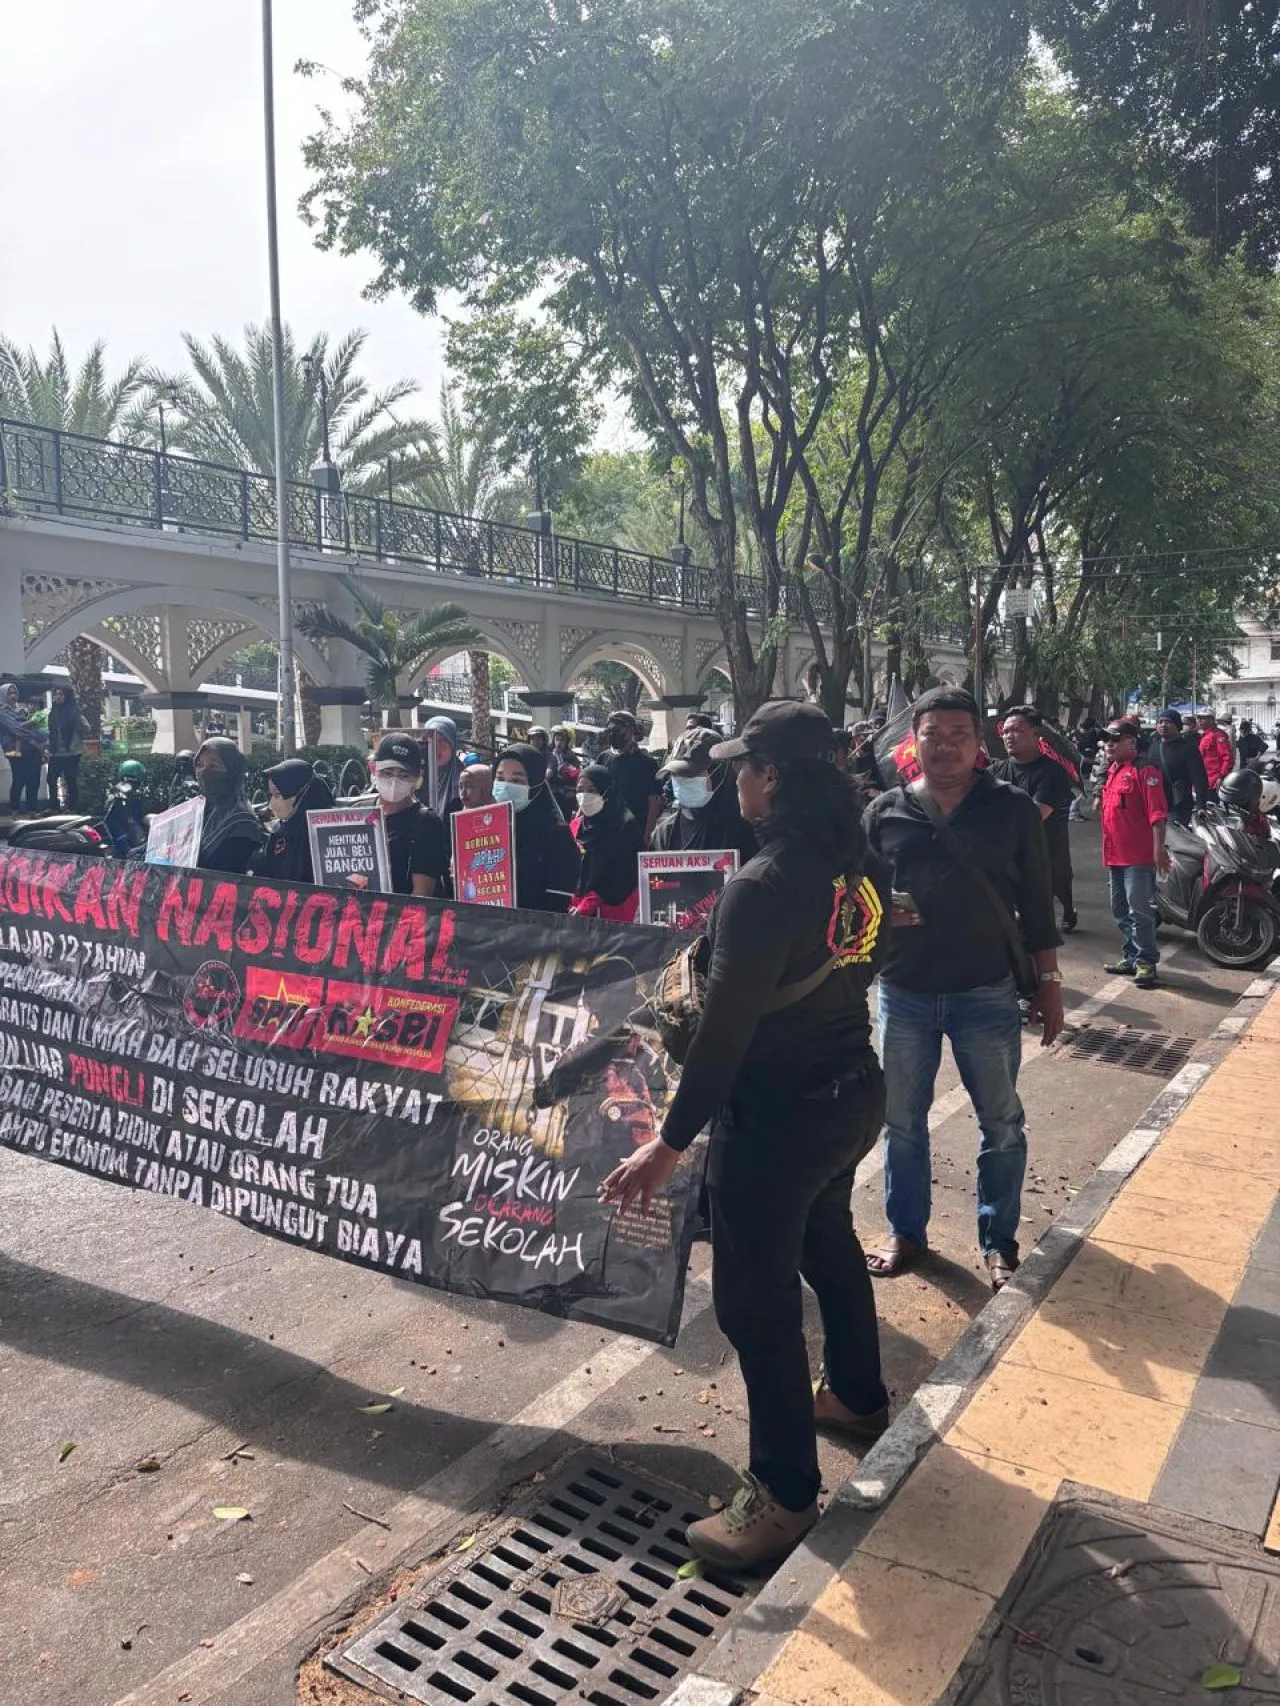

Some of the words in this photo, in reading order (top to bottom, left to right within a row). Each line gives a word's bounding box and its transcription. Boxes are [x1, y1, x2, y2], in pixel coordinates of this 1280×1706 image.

[324, 846, 351, 858] JUAL
[324, 857, 374, 873] BANGKU
[643, 856, 684, 868] SERUAN
[687, 856, 710, 867] AKSI
[157, 874, 469, 985] NASIONAL
[59, 934, 79, 962] 12
[82, 941, 146, 979] TAHUN
[387, 995, 448, 1014] KONFEDERASI
[42, 1007, 75, 1042] DAN
[148, 1034, 200, 1072] BAGI
[202, 1047, 314, 1099] SELURUH
[319, 1072, 443, 1125] RAKYAT
[69, 1053, 145, 1107] PUNGLI
[152, 1076, 174, 1117] DI
[182, 1086, 328, 1159] SEKOLAH
[0, 1075, 41, 1110] BAGI
[39, 1088, 112, 1137] PESERTA
[115, 1110, 161, 1154] DIDIK
[165, 1130, 226, 1174] ATAU
[228, 1149, 316, 1201] ORANG
[326, 1174, 378, 1219] TUA
[473, 1129, 534, 1156] ORANG
[451, 1151, 581, 1202] MISKIN
[135, 1156, 204, 1206] TANPA
[211, 1180, 329, 1243] DIPUNGUT
[337, 1218, 423, 1275] BIAYA
[439, 1202, 585, 1271] SEKOLAH
